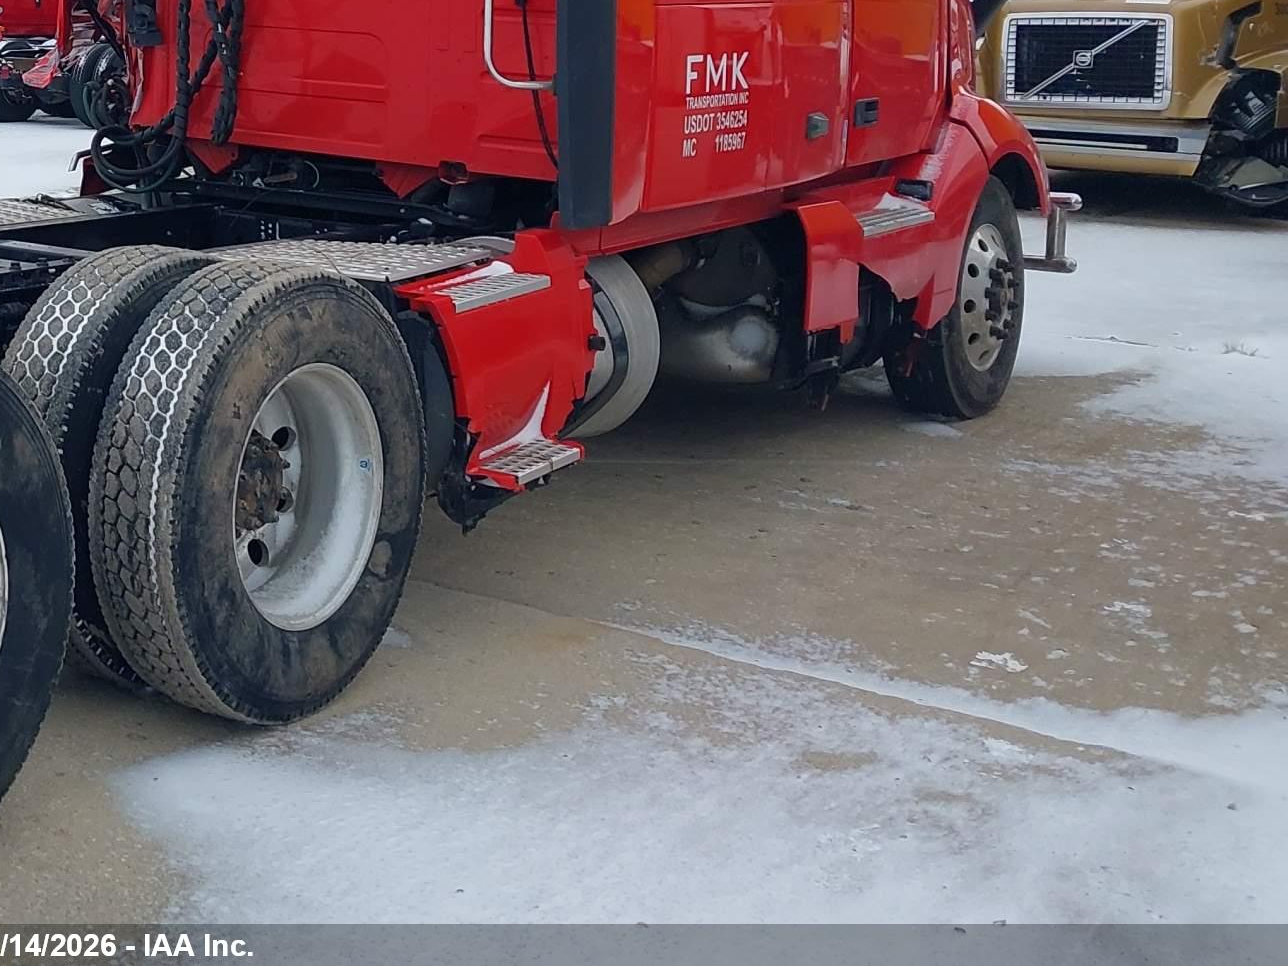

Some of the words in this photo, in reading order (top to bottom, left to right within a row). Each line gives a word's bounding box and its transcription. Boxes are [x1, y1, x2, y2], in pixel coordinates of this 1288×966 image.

[685, 51, 750, 95] FMK
[685, 94, 738, 109] TRANSPORTATION
[738, 91, 750, 104] INC
[684, 113, 715, 134] USDOT
[715, 109, 748, 131] 3546254
[682, 137, 697, 158] MC
[715, 132, 746, 153] 1185967
